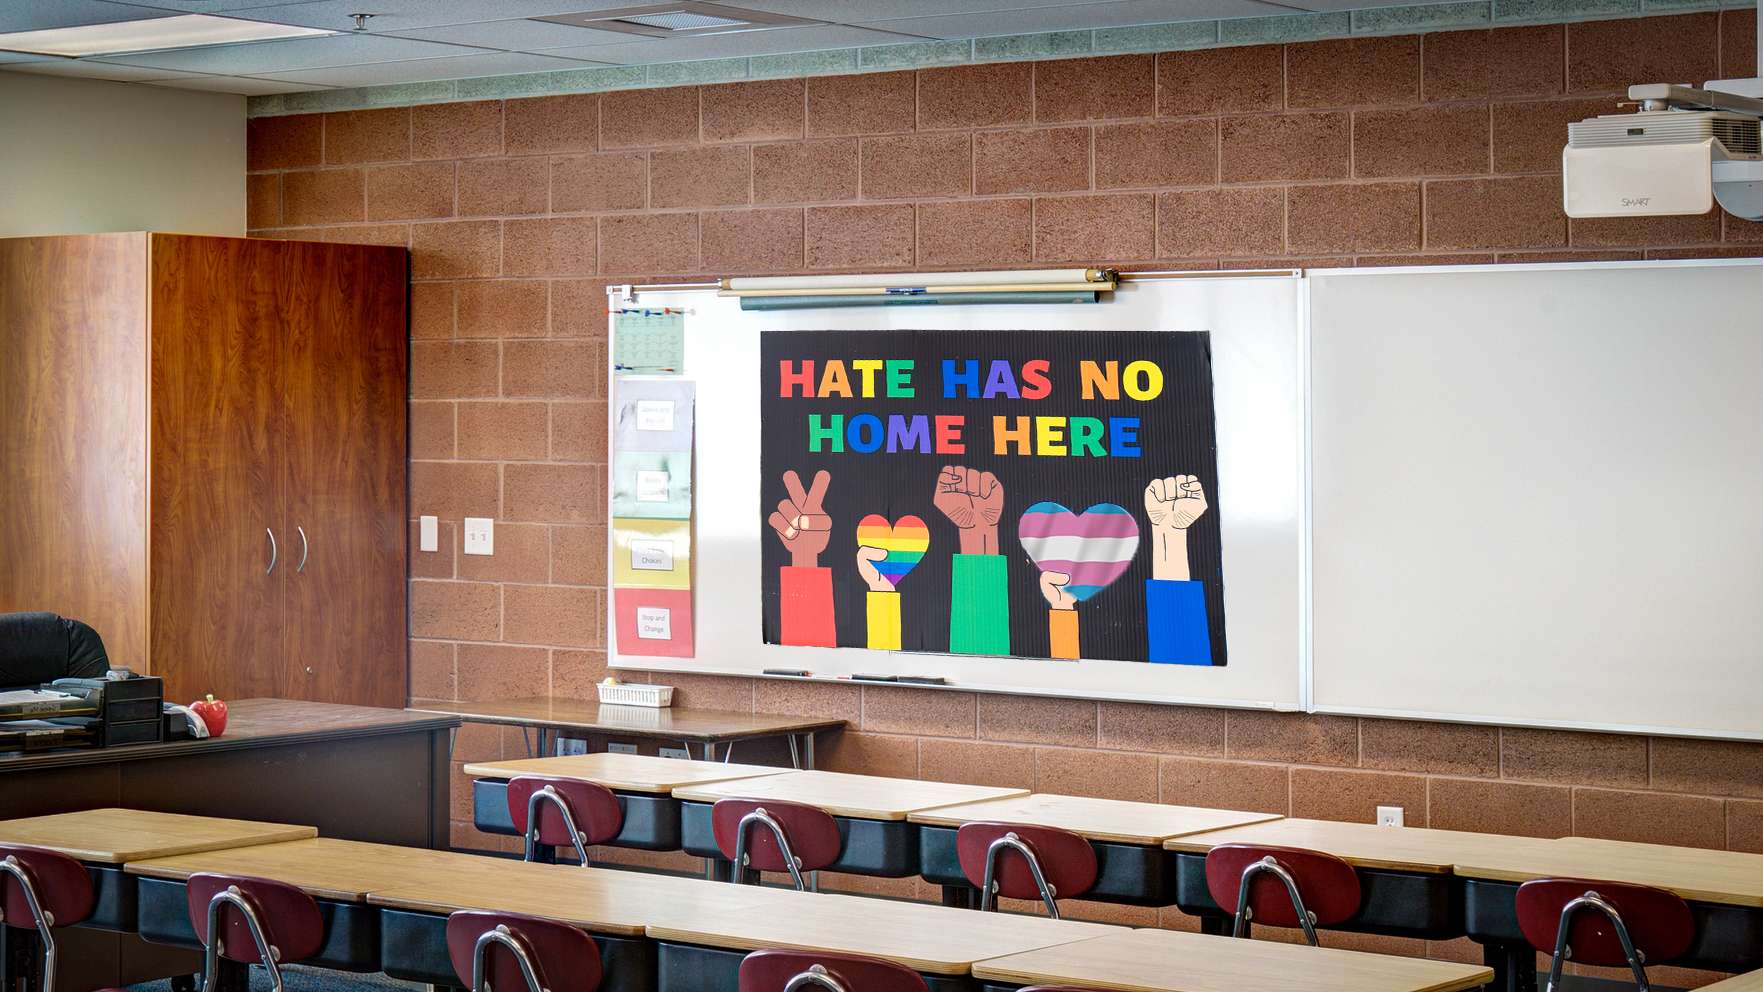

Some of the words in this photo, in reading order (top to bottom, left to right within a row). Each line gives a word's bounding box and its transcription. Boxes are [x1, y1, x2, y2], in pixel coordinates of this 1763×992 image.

[1621, 197, 1650, 207] SMART
[780, 359, 915, 400] HATE
[942, 360, 1052, 401] HAS
[1080, 360, 1164, 402] NO
[808, 414, 966, 455] HOME
[992, 415, 1142, 458] HERE
